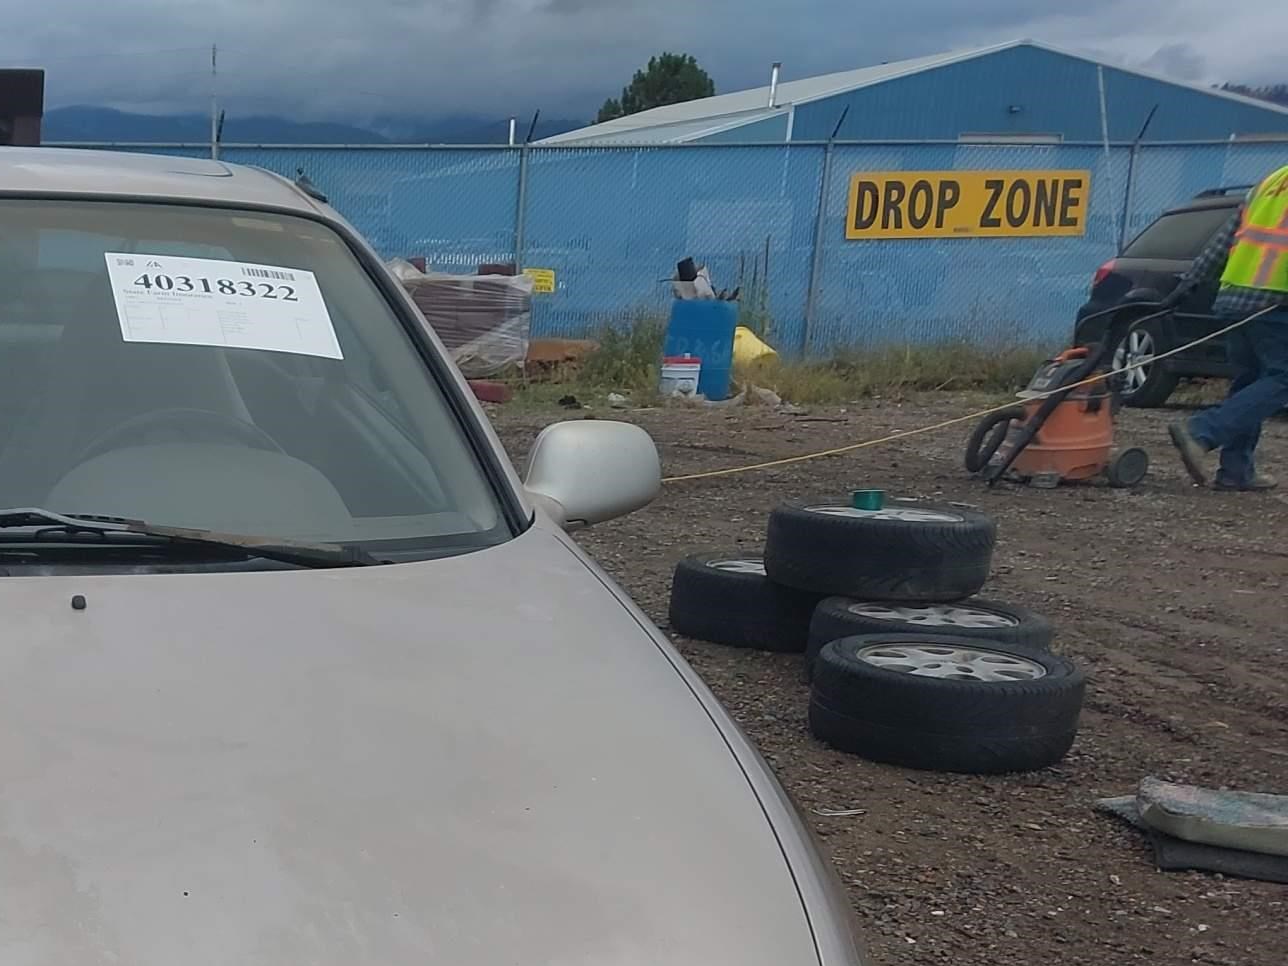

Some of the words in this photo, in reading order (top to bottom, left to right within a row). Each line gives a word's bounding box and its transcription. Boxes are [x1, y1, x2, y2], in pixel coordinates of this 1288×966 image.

[854, 180, 961, 230] DROP
[979, 179, 1083, 228] ZONE
[133, 272, 299, 302] 40318322
